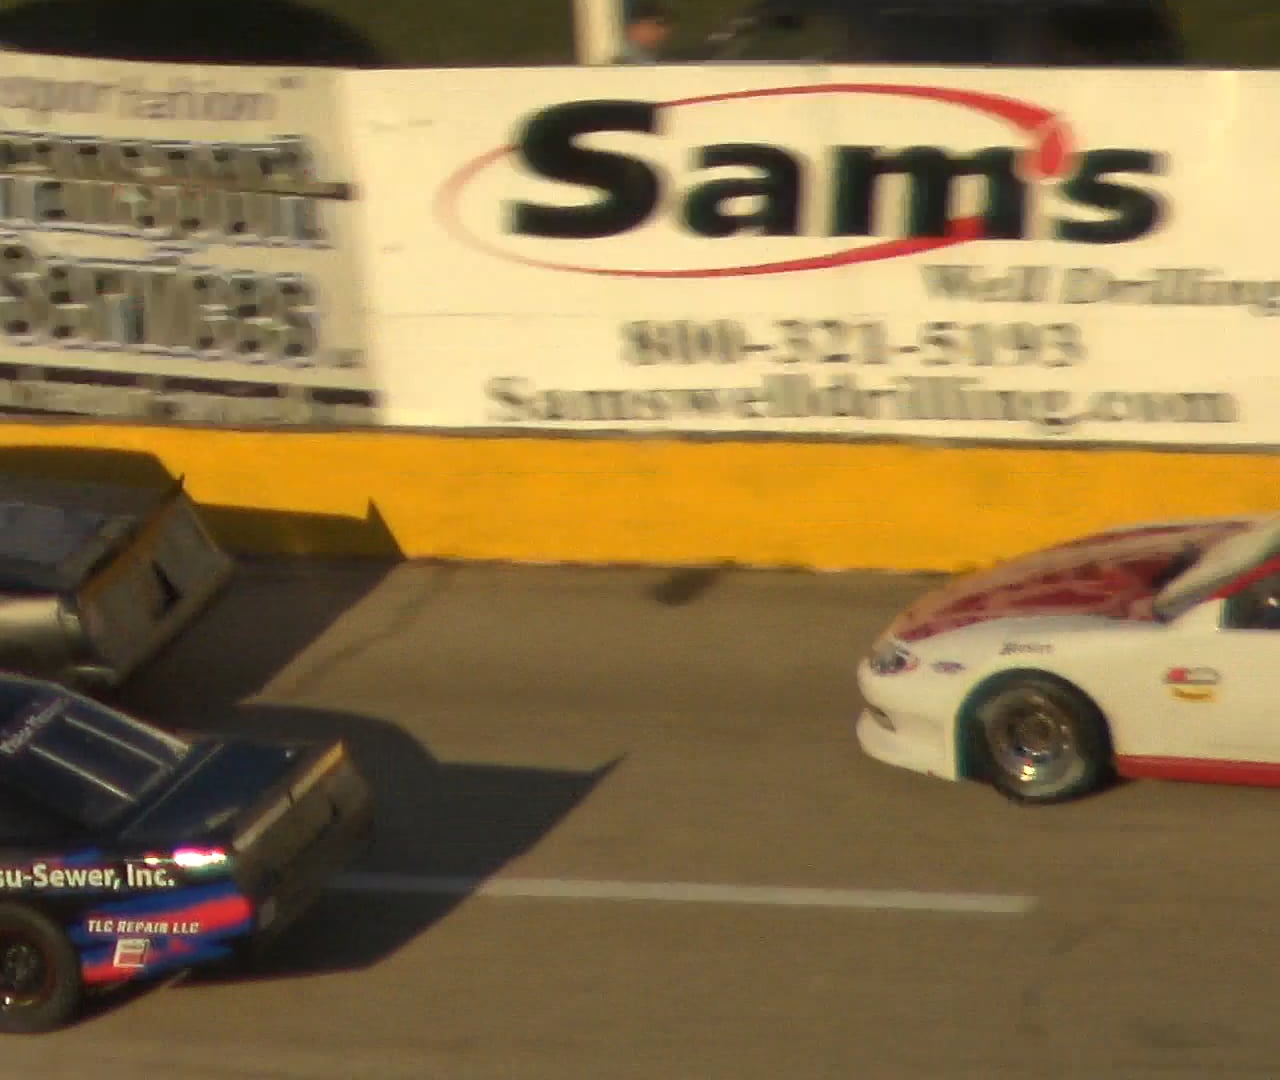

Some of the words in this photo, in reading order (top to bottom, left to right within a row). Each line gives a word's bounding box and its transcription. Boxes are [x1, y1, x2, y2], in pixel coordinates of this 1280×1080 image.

[920, 264, 1050, 304] Well
[620, 318, 1091, 368] 800-321-5193
[485, 373, 1243, 434] Samswelldrilling.com
[126, 863, 176, 888] Inc.
[88, 920, 114, 933] TLC
[117, 920, 169, 934] REPAIR
[172, 922, 200, 934] LLC
